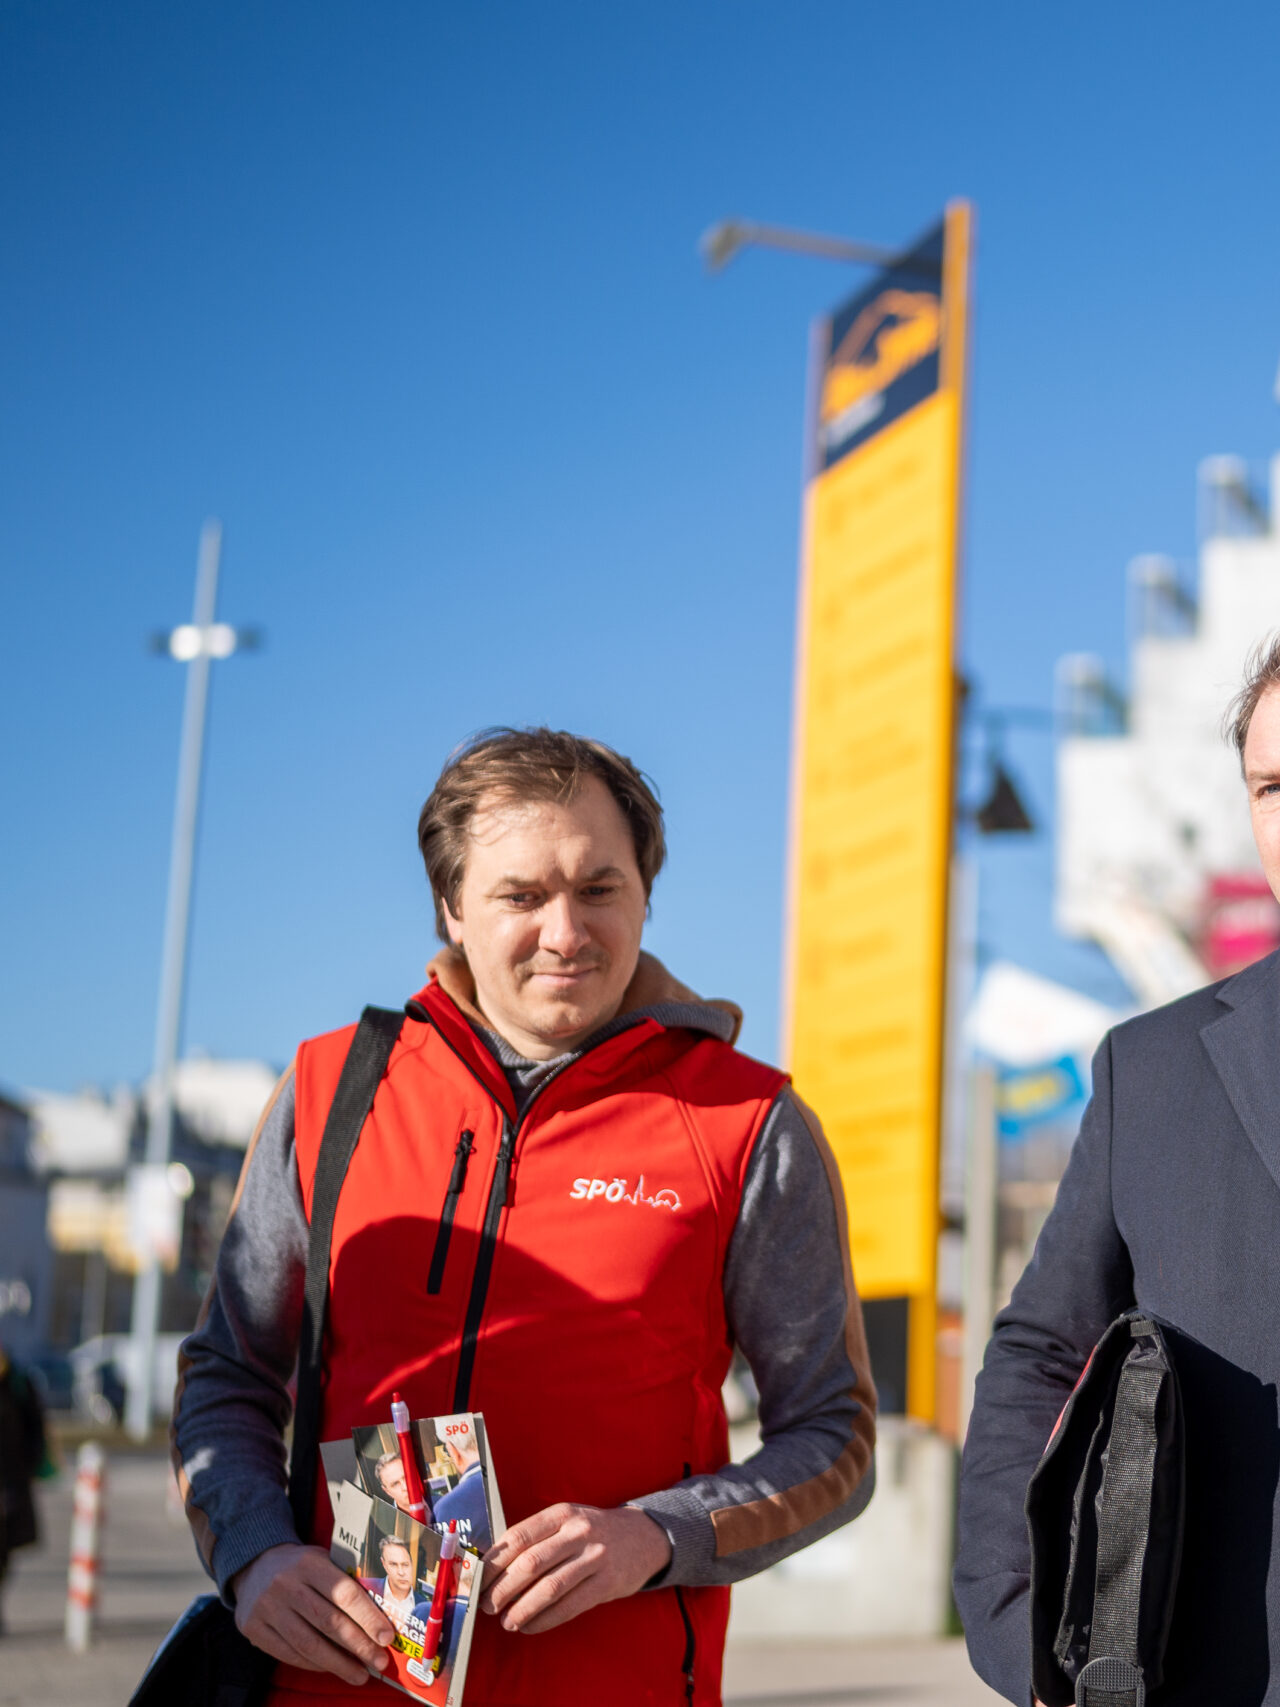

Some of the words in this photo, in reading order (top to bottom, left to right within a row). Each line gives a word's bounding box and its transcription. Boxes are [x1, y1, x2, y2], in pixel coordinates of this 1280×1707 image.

[569, 1177, 627, 1203] SPÖ
[445, 1420, 469, 1436] SPÖ
[339, 1526, 359, 1551] MIL
